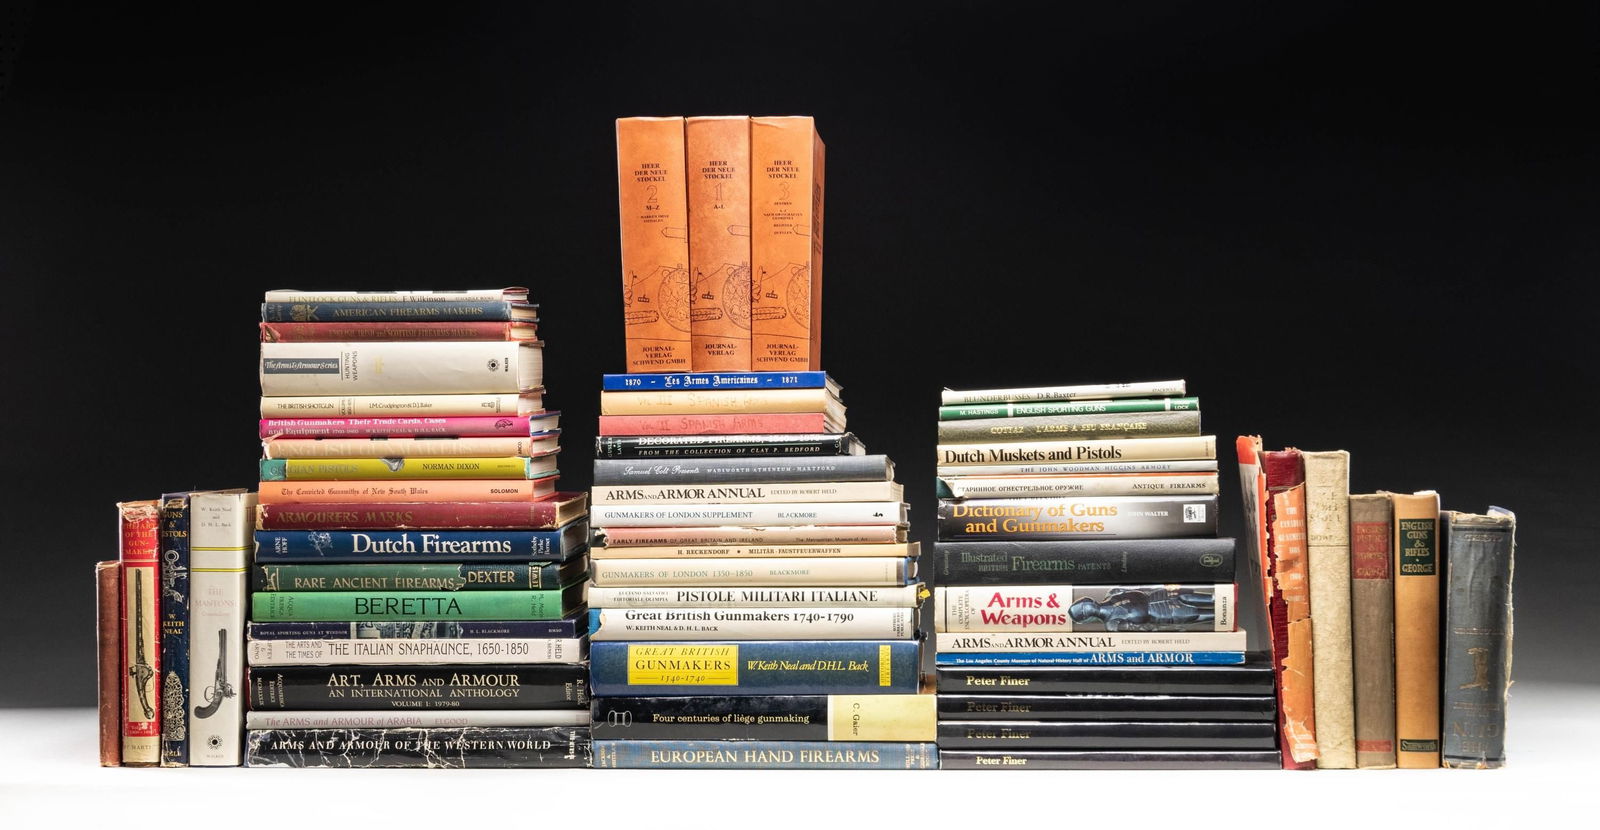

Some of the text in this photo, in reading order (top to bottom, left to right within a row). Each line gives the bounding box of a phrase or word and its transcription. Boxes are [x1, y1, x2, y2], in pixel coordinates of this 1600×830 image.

[333, 307, 482, 317] AMERICAN FIREARMS MAKERS
[625, 375, 708, 386] 1870 Armes
[1016, 406, 1047, 415] ENGLISH
[1047, 404, 1083, 414] SPORTING
[1086, 403, 1108, 412] GUNS
[348, 418, 371, 426] Their
[944, 444, 1122, 463] Dutch Muskets and Pistols
[422, 463, 480, 471] NORMAN DIXON
[652, 464, 670, 475] Colt
[1062, 465, 1100, 473] WOODMAN
[1104, 464, 1136, 472] HIGGINS
[1131, 481, 1207, 491] ANTIQUE FIREARMS
[605, 487, 766, 500] ARMS ARMOR ANNUAL
[275, 511, 357, 523] ARMOURERS
[604, 511, 654, 519] GUNMAKERS
[655, 511, 667, 519] OF
[667, 511, 701, 519] LONDON
[702, 511, 753, 519] SUPPLEMENT
[952, 502, 1118, 522] Dictionary of Guns
[169, 520, 176, 528] &
[964, 517, 1105, 533] and Gunmakers
[1401, 521, 1433, 531] ENGLISH
[1406, 531, 1428, 540] GUNS
[351, 533, 511, 553] Dutch Firearms
[1413, 540, 1425, 549] &
[1404, 548, 1429, 557] RIFLES
[959, 551, 1007, 563] Illustrated
[1010, 555, 1076, 571] Firearms
[1401, 563, 1433, 573] GEORGE
[294, 570, 514, 588] RARE ANCIENT DEXTER
[530, 566, 538, 587] LEWIS
[602, 571, 655, 580] GUNMAKERS
[657, 571, 670, 579] OF
[672, 571, 708, 579] LONDON
[677, 589, 878, 602] PISTOLE MILITARI ITALIANE
[986, 591, 1062, 609] Arms &
[354, 597, 462, 614] BERETTA
[1220, 595, 1228, 625] Bonanza
[625, 609, 789, 621] Great Gunmakers
[979, 608, 1067, 629] Weapons
[162, 620, 186, 628] KEITH
[701, 625, 719, 633] BACK
[952, 635, 1174, 648] ARMS ARMOR ANNUAL EDITED ROBERT
[286, 649, 323, 659] THE TIMES OF
[328, 642, 528, 658] THE ITALIAN SNAPHAUNCE, 1650-1850
[635, 647, 730, 656] GREAT BRITISH
[635, 659, 731, 670] GUNMAKERS
[974, 652, 1195, 665] Angeles ARMS and ARMOR
[747, 660, 871, 672] W. Keith Neal and Back
[326, 672, 520, 689] ART, ARMS AND ARMOUR
[965, 674, 1031, 687] Peter Finer
[328, 688, 520, 698] AN INTERNATIONAL ANTHOLOGY
[564, 682, 572, 700] Editor
[966, 700, 1032, 713] Peter Finer
[265, 717, 281, 726] The
[282, 717, 310, 726] ARMS
[312, 717, 330, 726] and
[331, 717, 374, 726] ARMOUR
[376, 717, 386, 726] of
[386, 716, 421, 725] ARABIA
[652, 713, 810, 725] Four centuries of gunmaking
[852, 713, 861, 736] Gaier
[966, 727, 1032, 739] Peter Finer
[271, 740, 551, 750] ARMS AND OF WESTERN WORLD
[650, 749, 880, 763] EUROPEAN HAND FIREARMS
[975, 755, 1029, 765] Peter Finer
